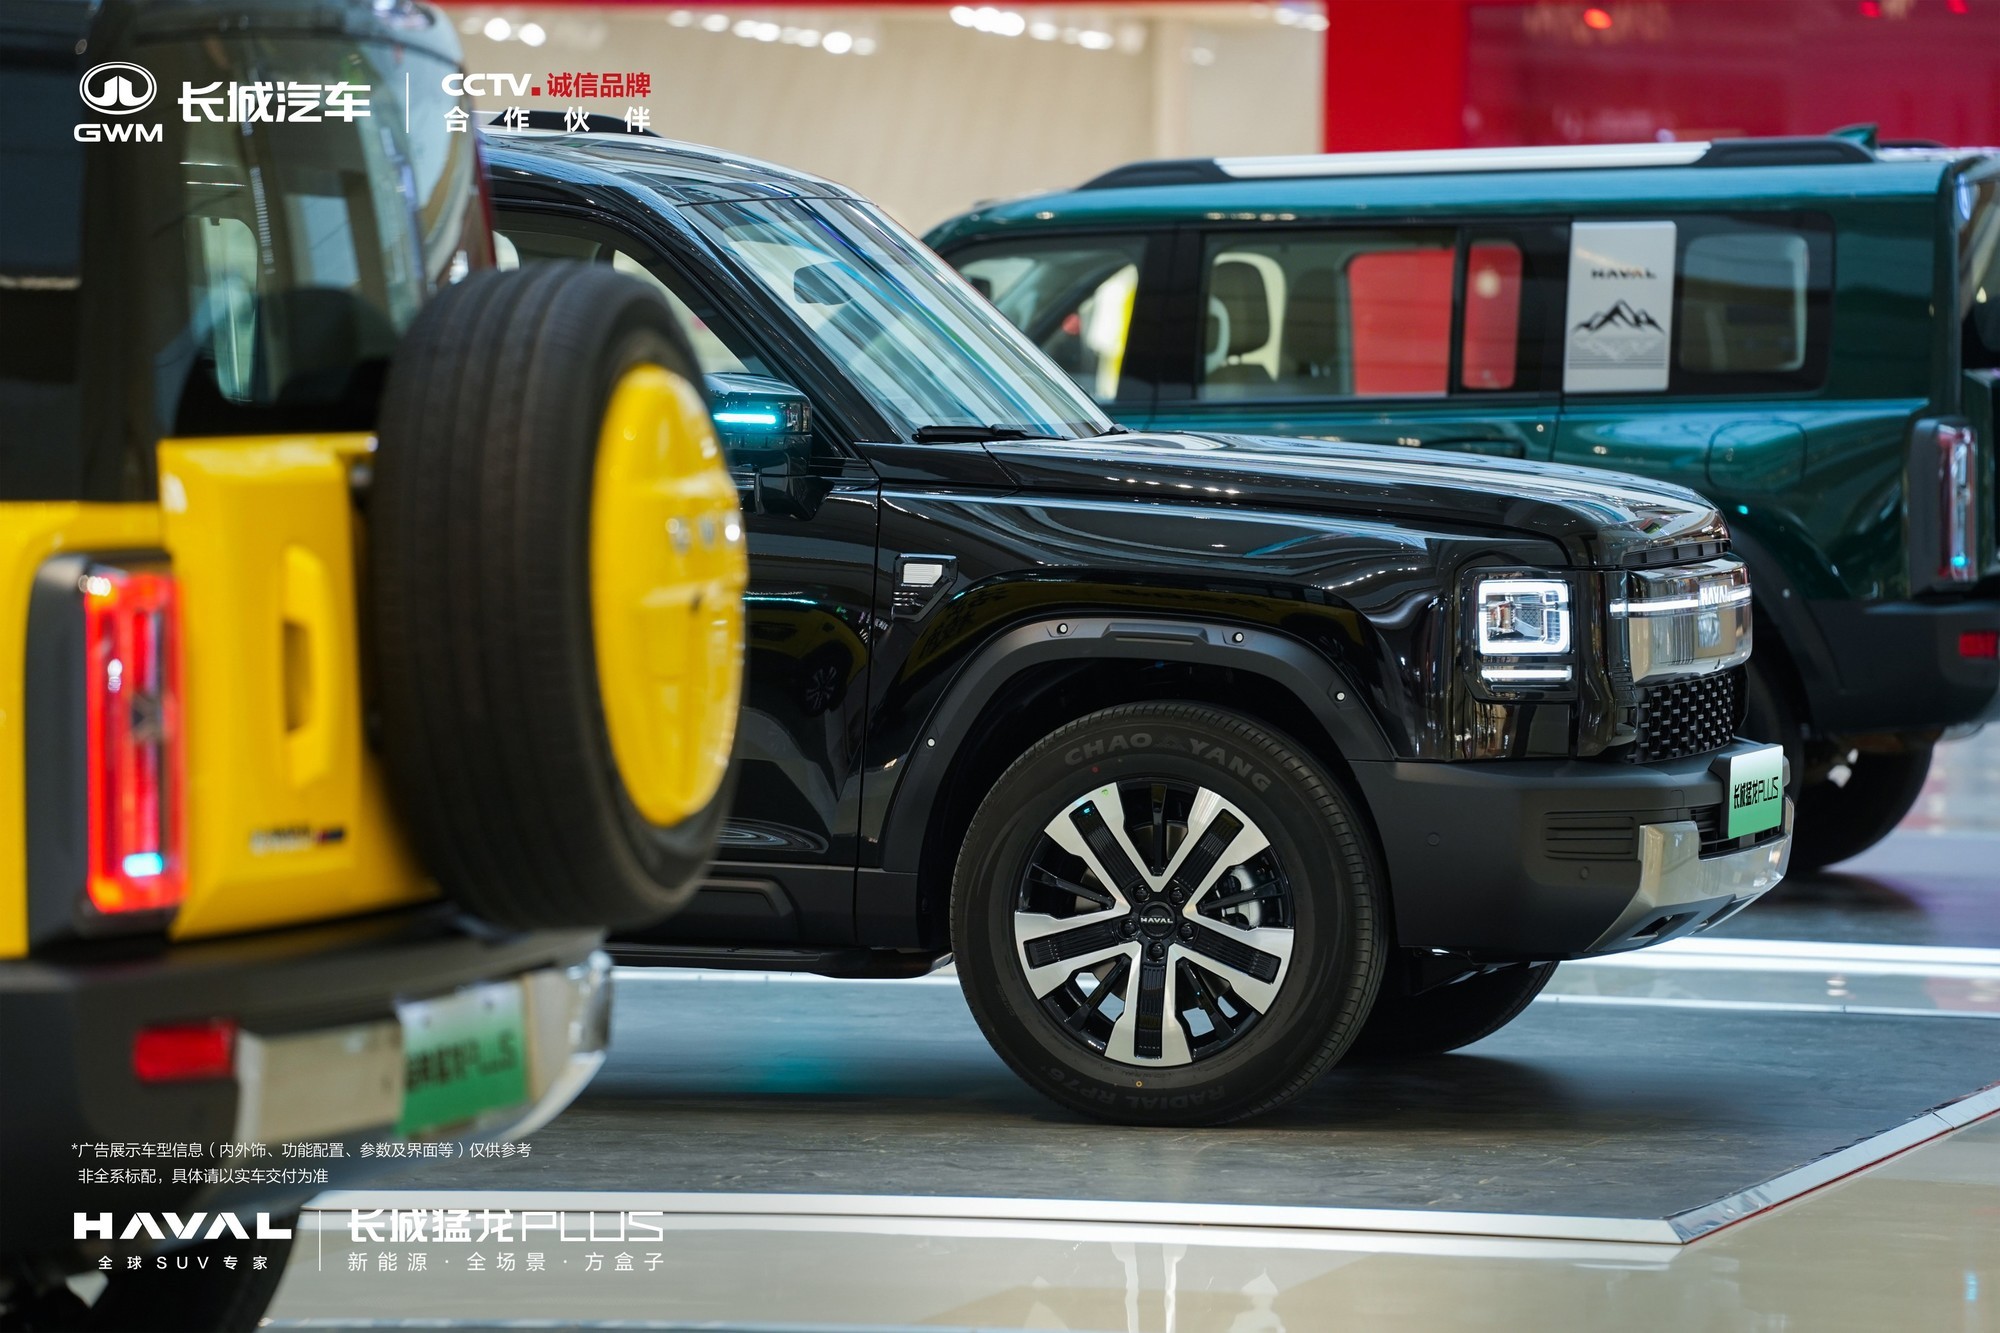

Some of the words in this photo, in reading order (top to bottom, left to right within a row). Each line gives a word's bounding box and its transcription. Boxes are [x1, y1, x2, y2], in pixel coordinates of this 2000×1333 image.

[1590, 266, 1657, 280] HAVAL
[1064, 732, 1153, 766] CHAO
[1189, 737, 1272, 793] YANG
[1124, 1084, 1226, 1111] RADIAL
